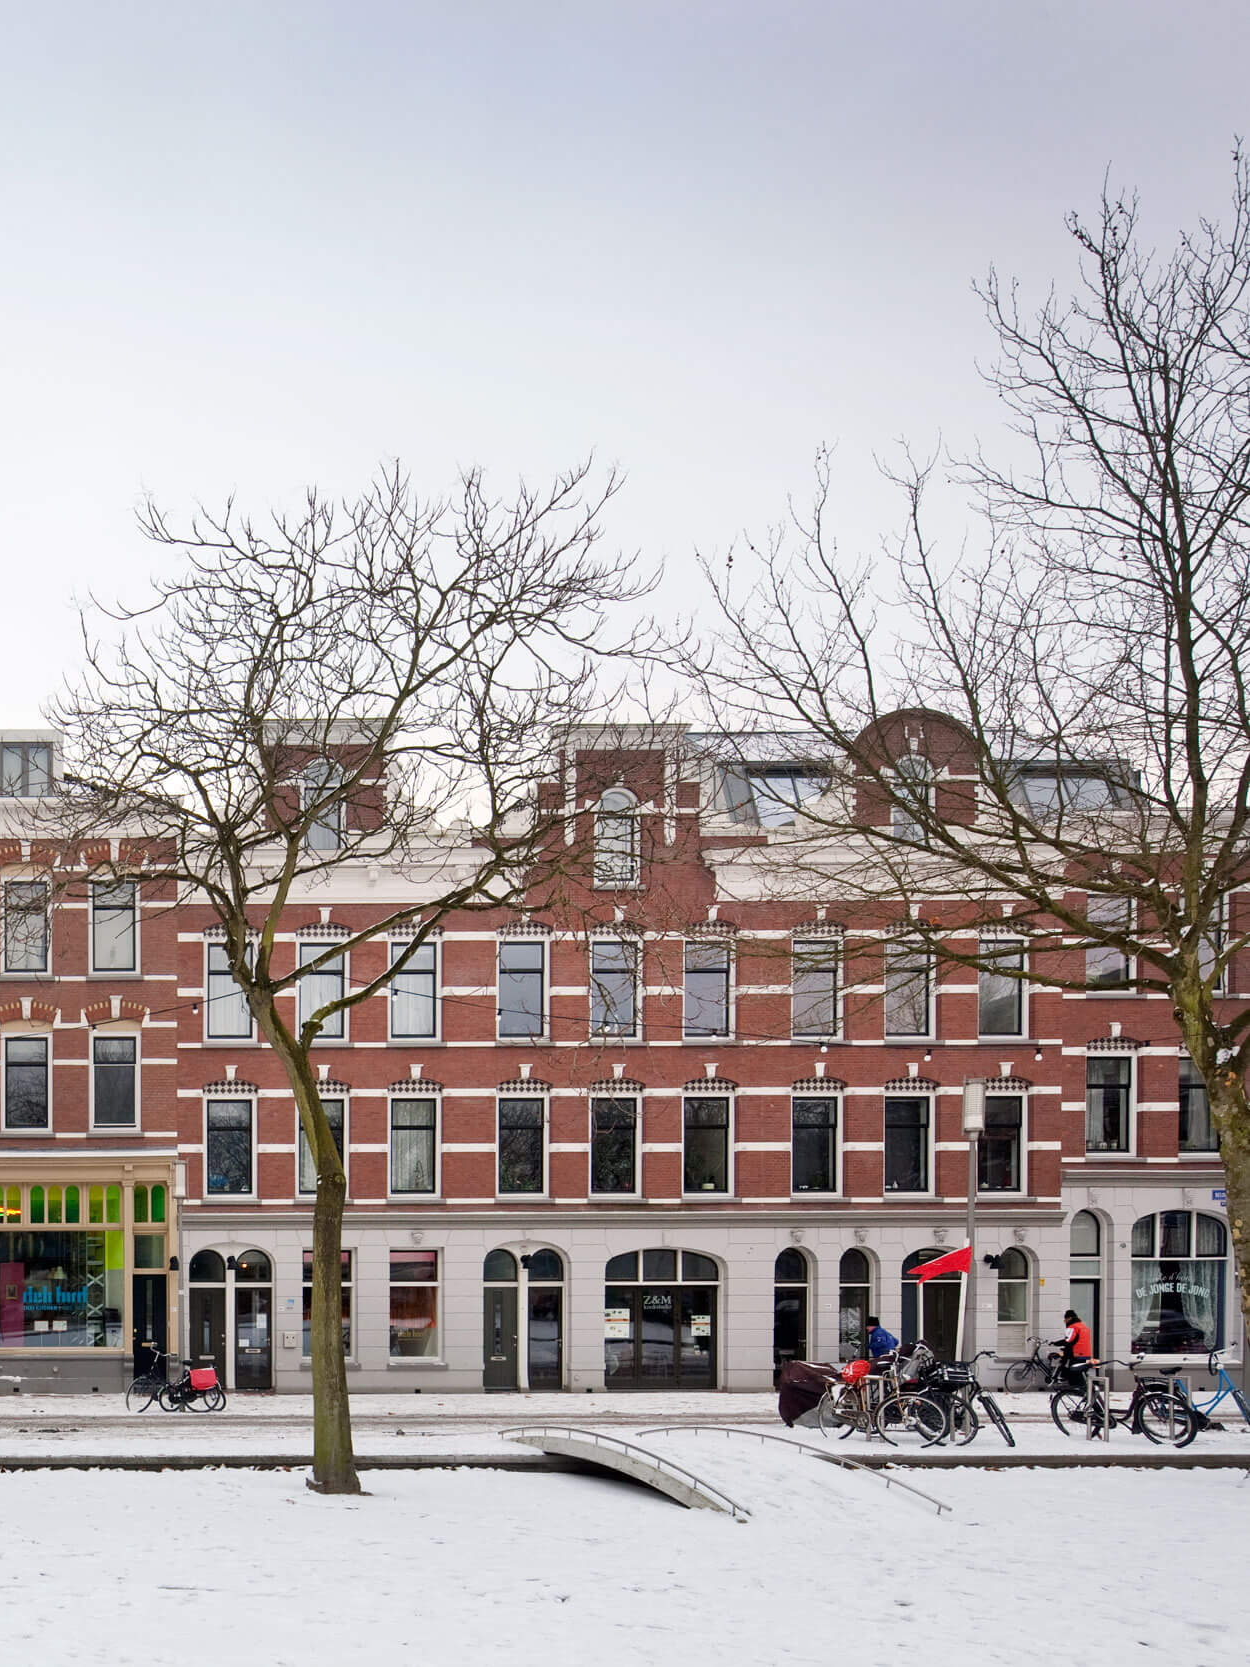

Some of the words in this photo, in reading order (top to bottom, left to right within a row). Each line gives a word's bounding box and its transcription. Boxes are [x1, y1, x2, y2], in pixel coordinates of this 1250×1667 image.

[1135, 1287, 1148, 1299] DE
[1150, 1282, 1174, 1295] JONGE
[1176, 1282, 1188, 1293] DE
[642, 1295, 672, 1305] Z&M
